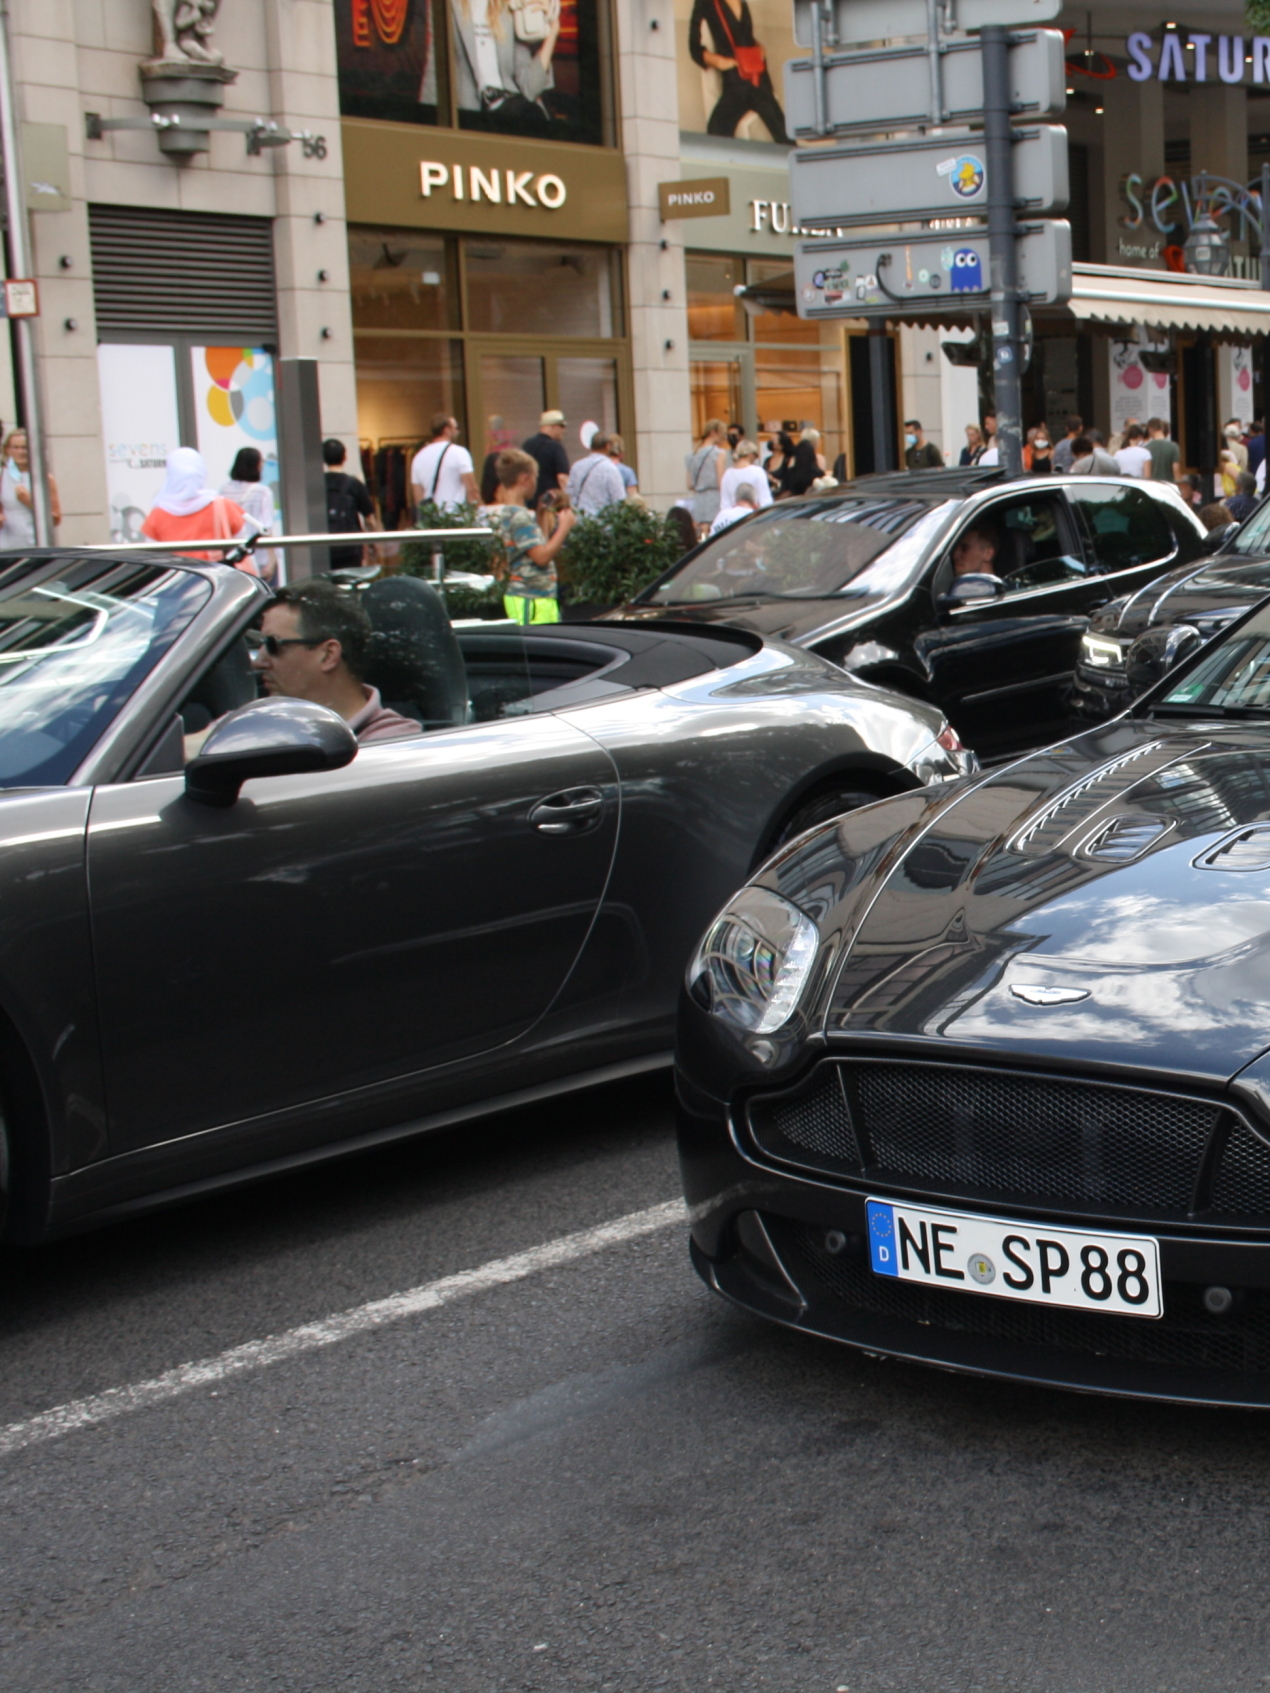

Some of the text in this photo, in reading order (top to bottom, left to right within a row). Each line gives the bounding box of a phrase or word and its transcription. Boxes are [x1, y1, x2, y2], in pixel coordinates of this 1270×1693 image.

[303, 136, 327, 159] 56
[420, 161, 566, 208] PINKO
[668, 191, 715, 206] PINKO
[1119, 238, 1147, 256] home
[1149, 241, 1160, 260] of
[879, 1246, 889, 1262] D
[898, 1217, 965, 1280] NE
